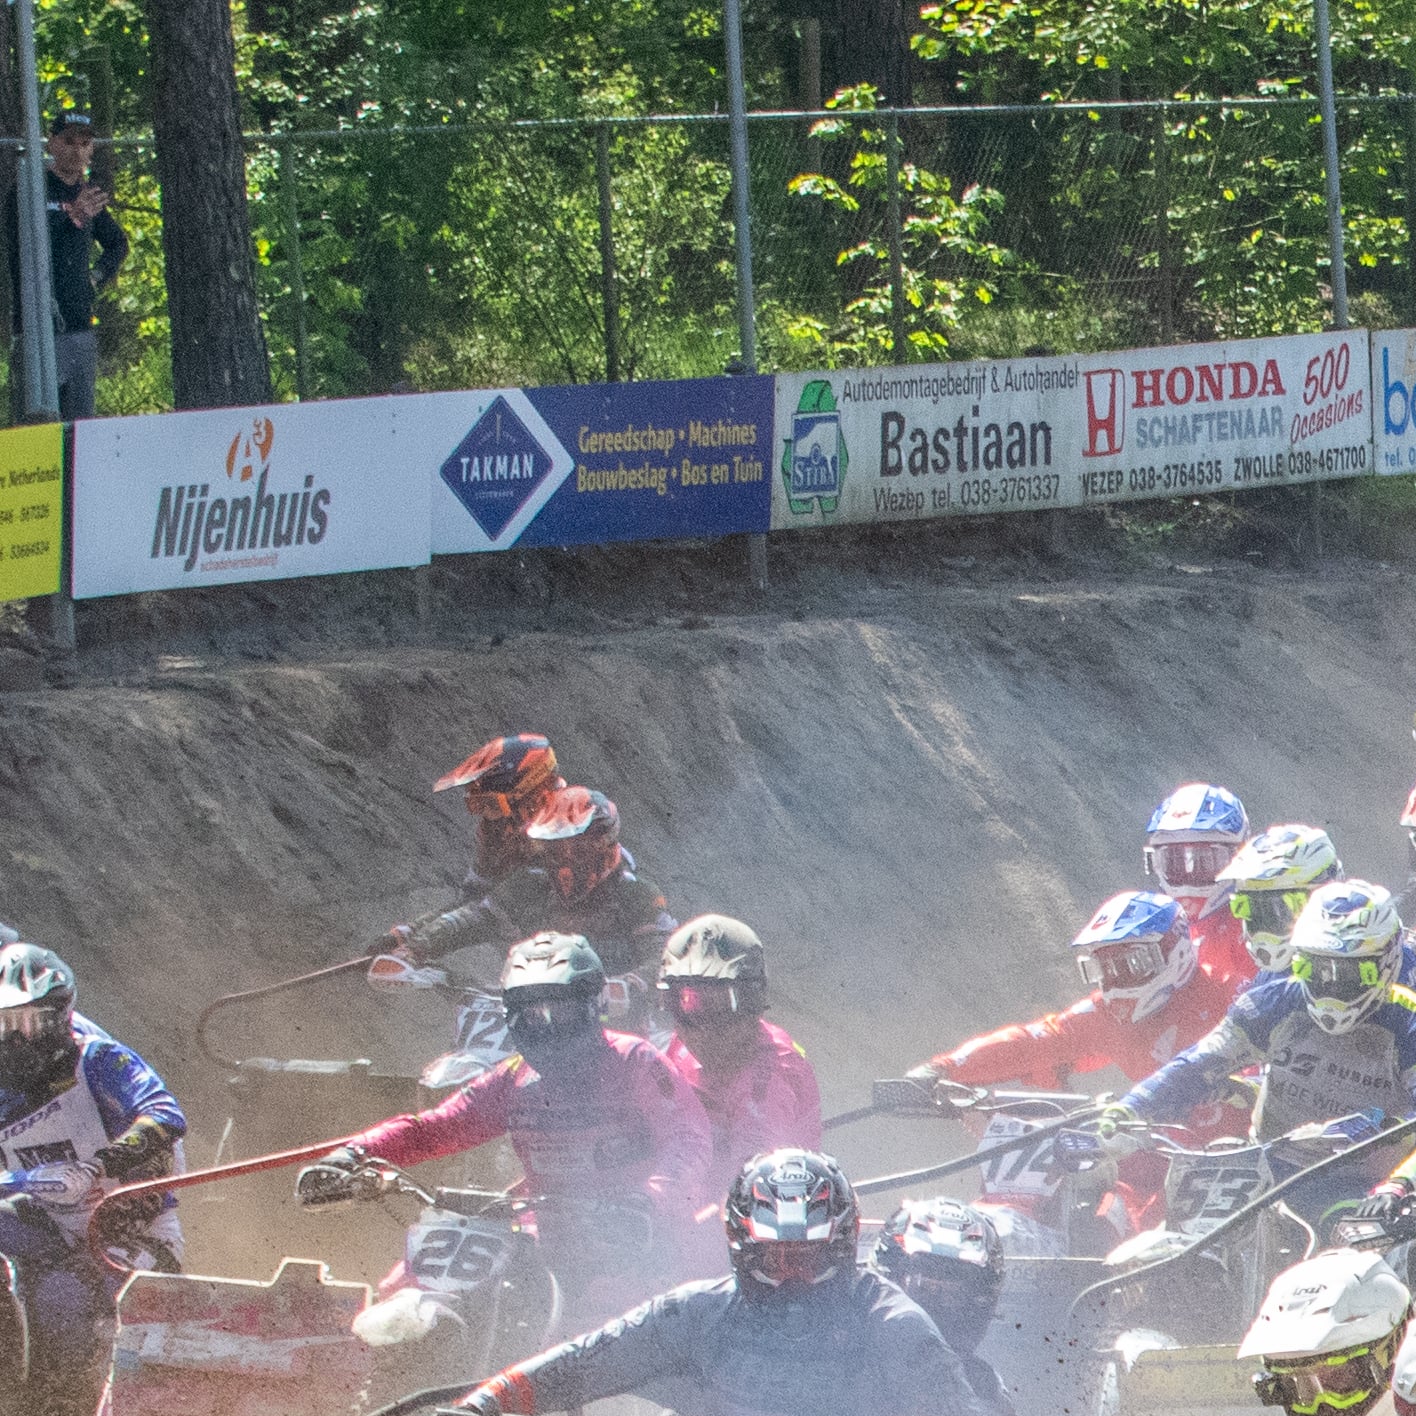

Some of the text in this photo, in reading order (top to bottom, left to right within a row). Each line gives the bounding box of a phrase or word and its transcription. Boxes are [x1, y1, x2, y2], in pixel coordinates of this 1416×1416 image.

[842, 361, 1081, 405] Autodemontagebedrijf & Autohandel
[1131, 359, 1287, 409] HONDA
[1303, 343, 1351, 405] 500
[578, 420, 757, 457] Gereedschap Machines
[1136, 405, 1284, 449] SCHAFTENAAR
[1289, 389, 1363, 444] Occasions
[879, 405, 1052, 477] Bastiaan
[460, 453, 535, 483] TAKMAN
[577, 456, 764, 495] Bouwbeslag Bos en Tuin
[1079, 470, 1124, 496] WEZEP
[1233, 453, 1284, 482] ZWOLLE
[150, 463, 331, 572] Nijenhuis
[872, 486, 925, 513] Wezep
[412, 1229, 497, 1279] 26
